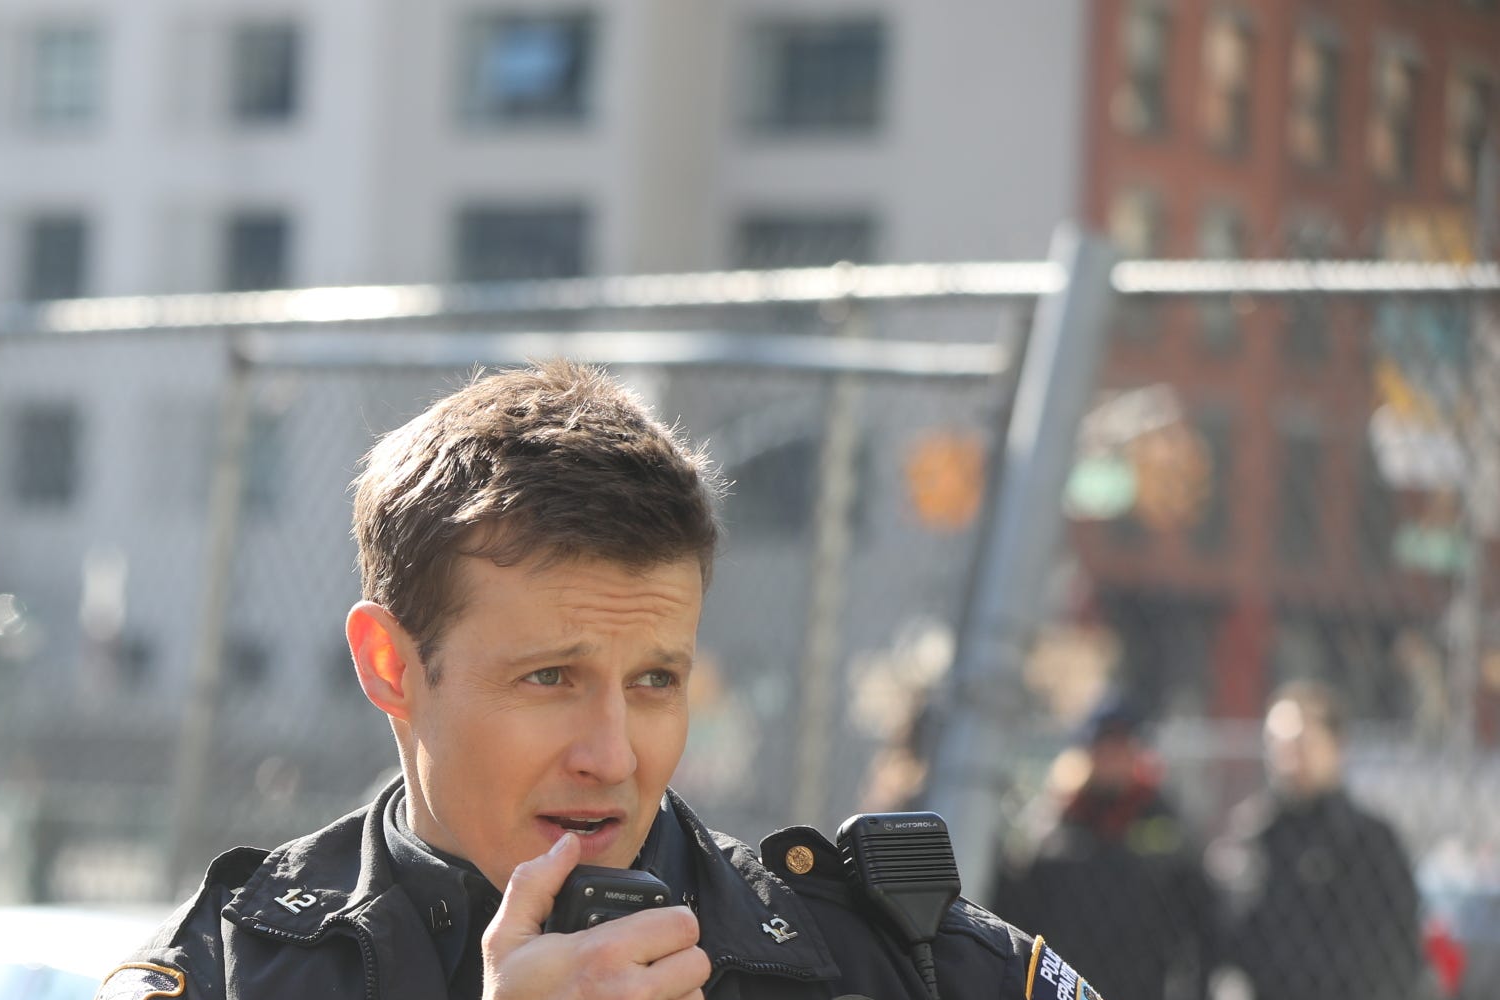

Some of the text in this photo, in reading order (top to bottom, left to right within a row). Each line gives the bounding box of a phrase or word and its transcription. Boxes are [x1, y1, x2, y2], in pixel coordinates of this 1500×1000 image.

[894, 821, 938, 829] MOTOROLA
[274, 888, 317, 914] 12
[761, 917, 798, 943] 12
